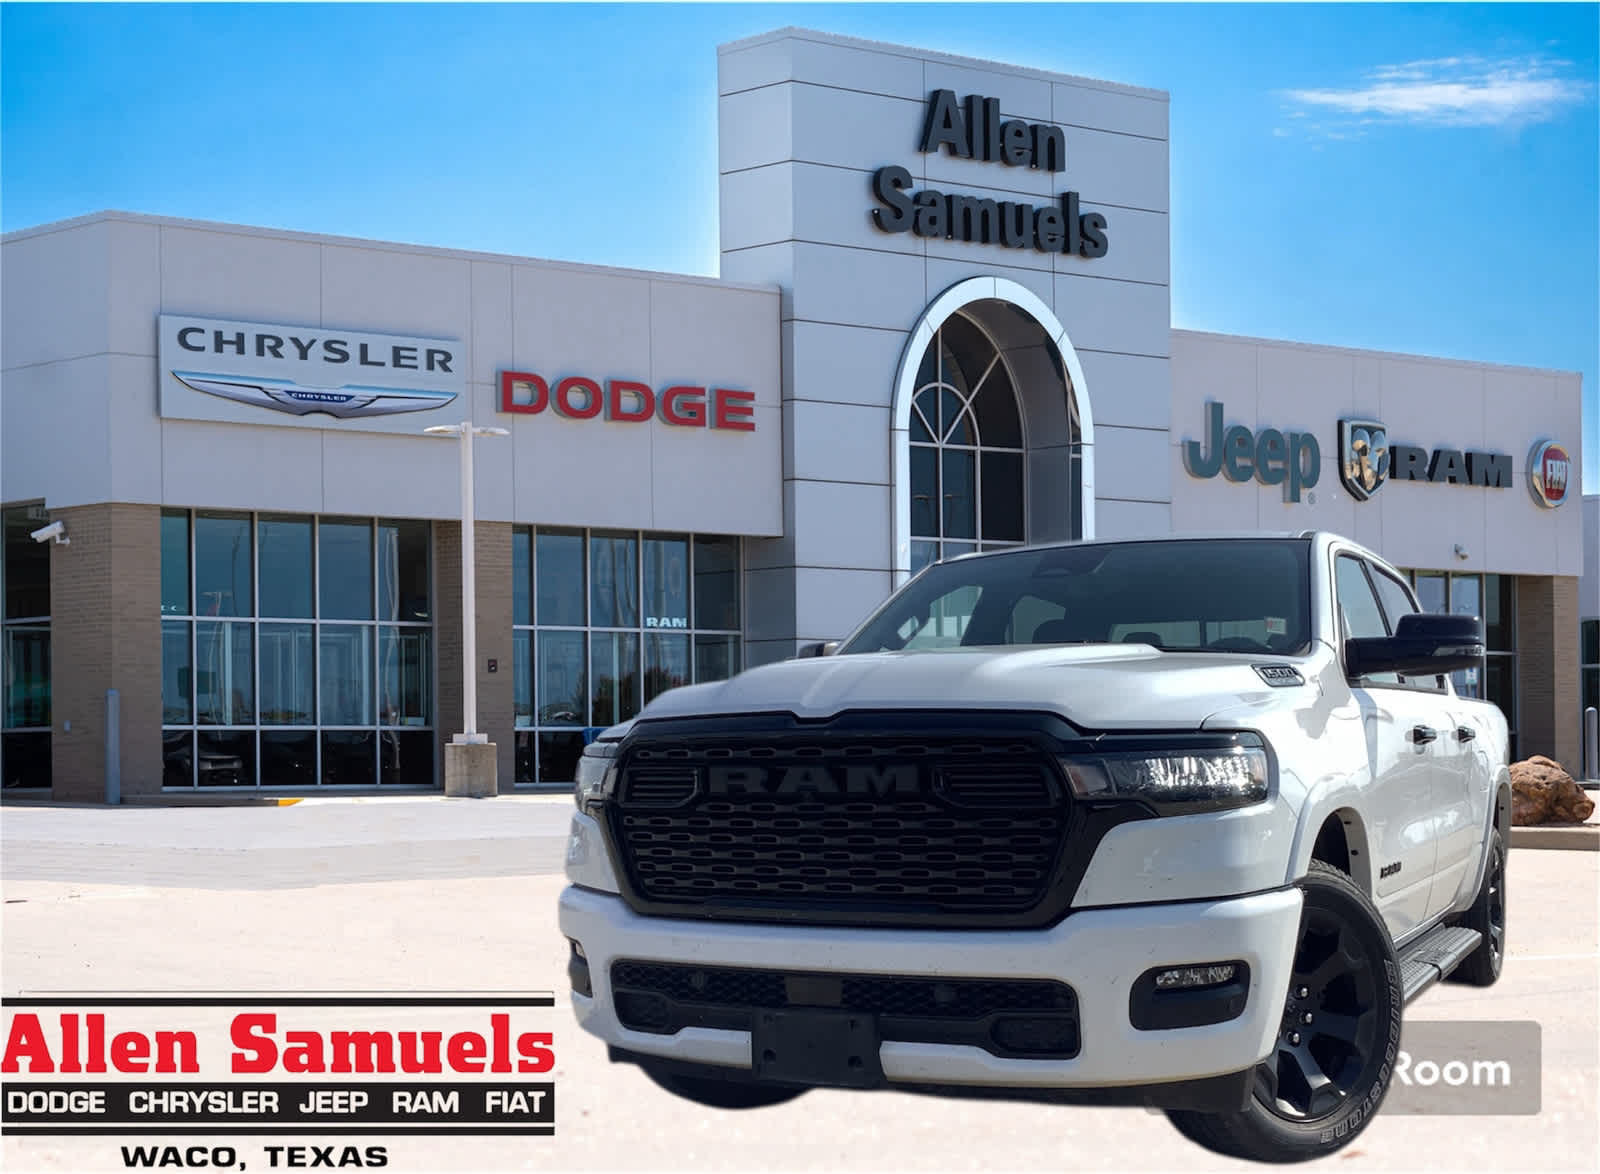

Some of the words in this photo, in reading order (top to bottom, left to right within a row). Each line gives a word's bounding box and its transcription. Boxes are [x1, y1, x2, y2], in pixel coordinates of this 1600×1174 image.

[919, 88, 1066, 173] Allen
[871, 165, 1109, 258] Samuels
[177, 326, 455, 373] CHRYSLER
[291, 393, 347, 402] CHRYSLER
[496, 370, 756, 432] DODGE
[1182, 401, 1321, 503] Jeep
[1388, 445, 1513, 489] RAM
[1546, 459, 1567, 490] FIAT
[646, 617, 687, 628] RAM
[1260, 666, 1298, 679] 1500
[709, 766, 920, 795] RAM
